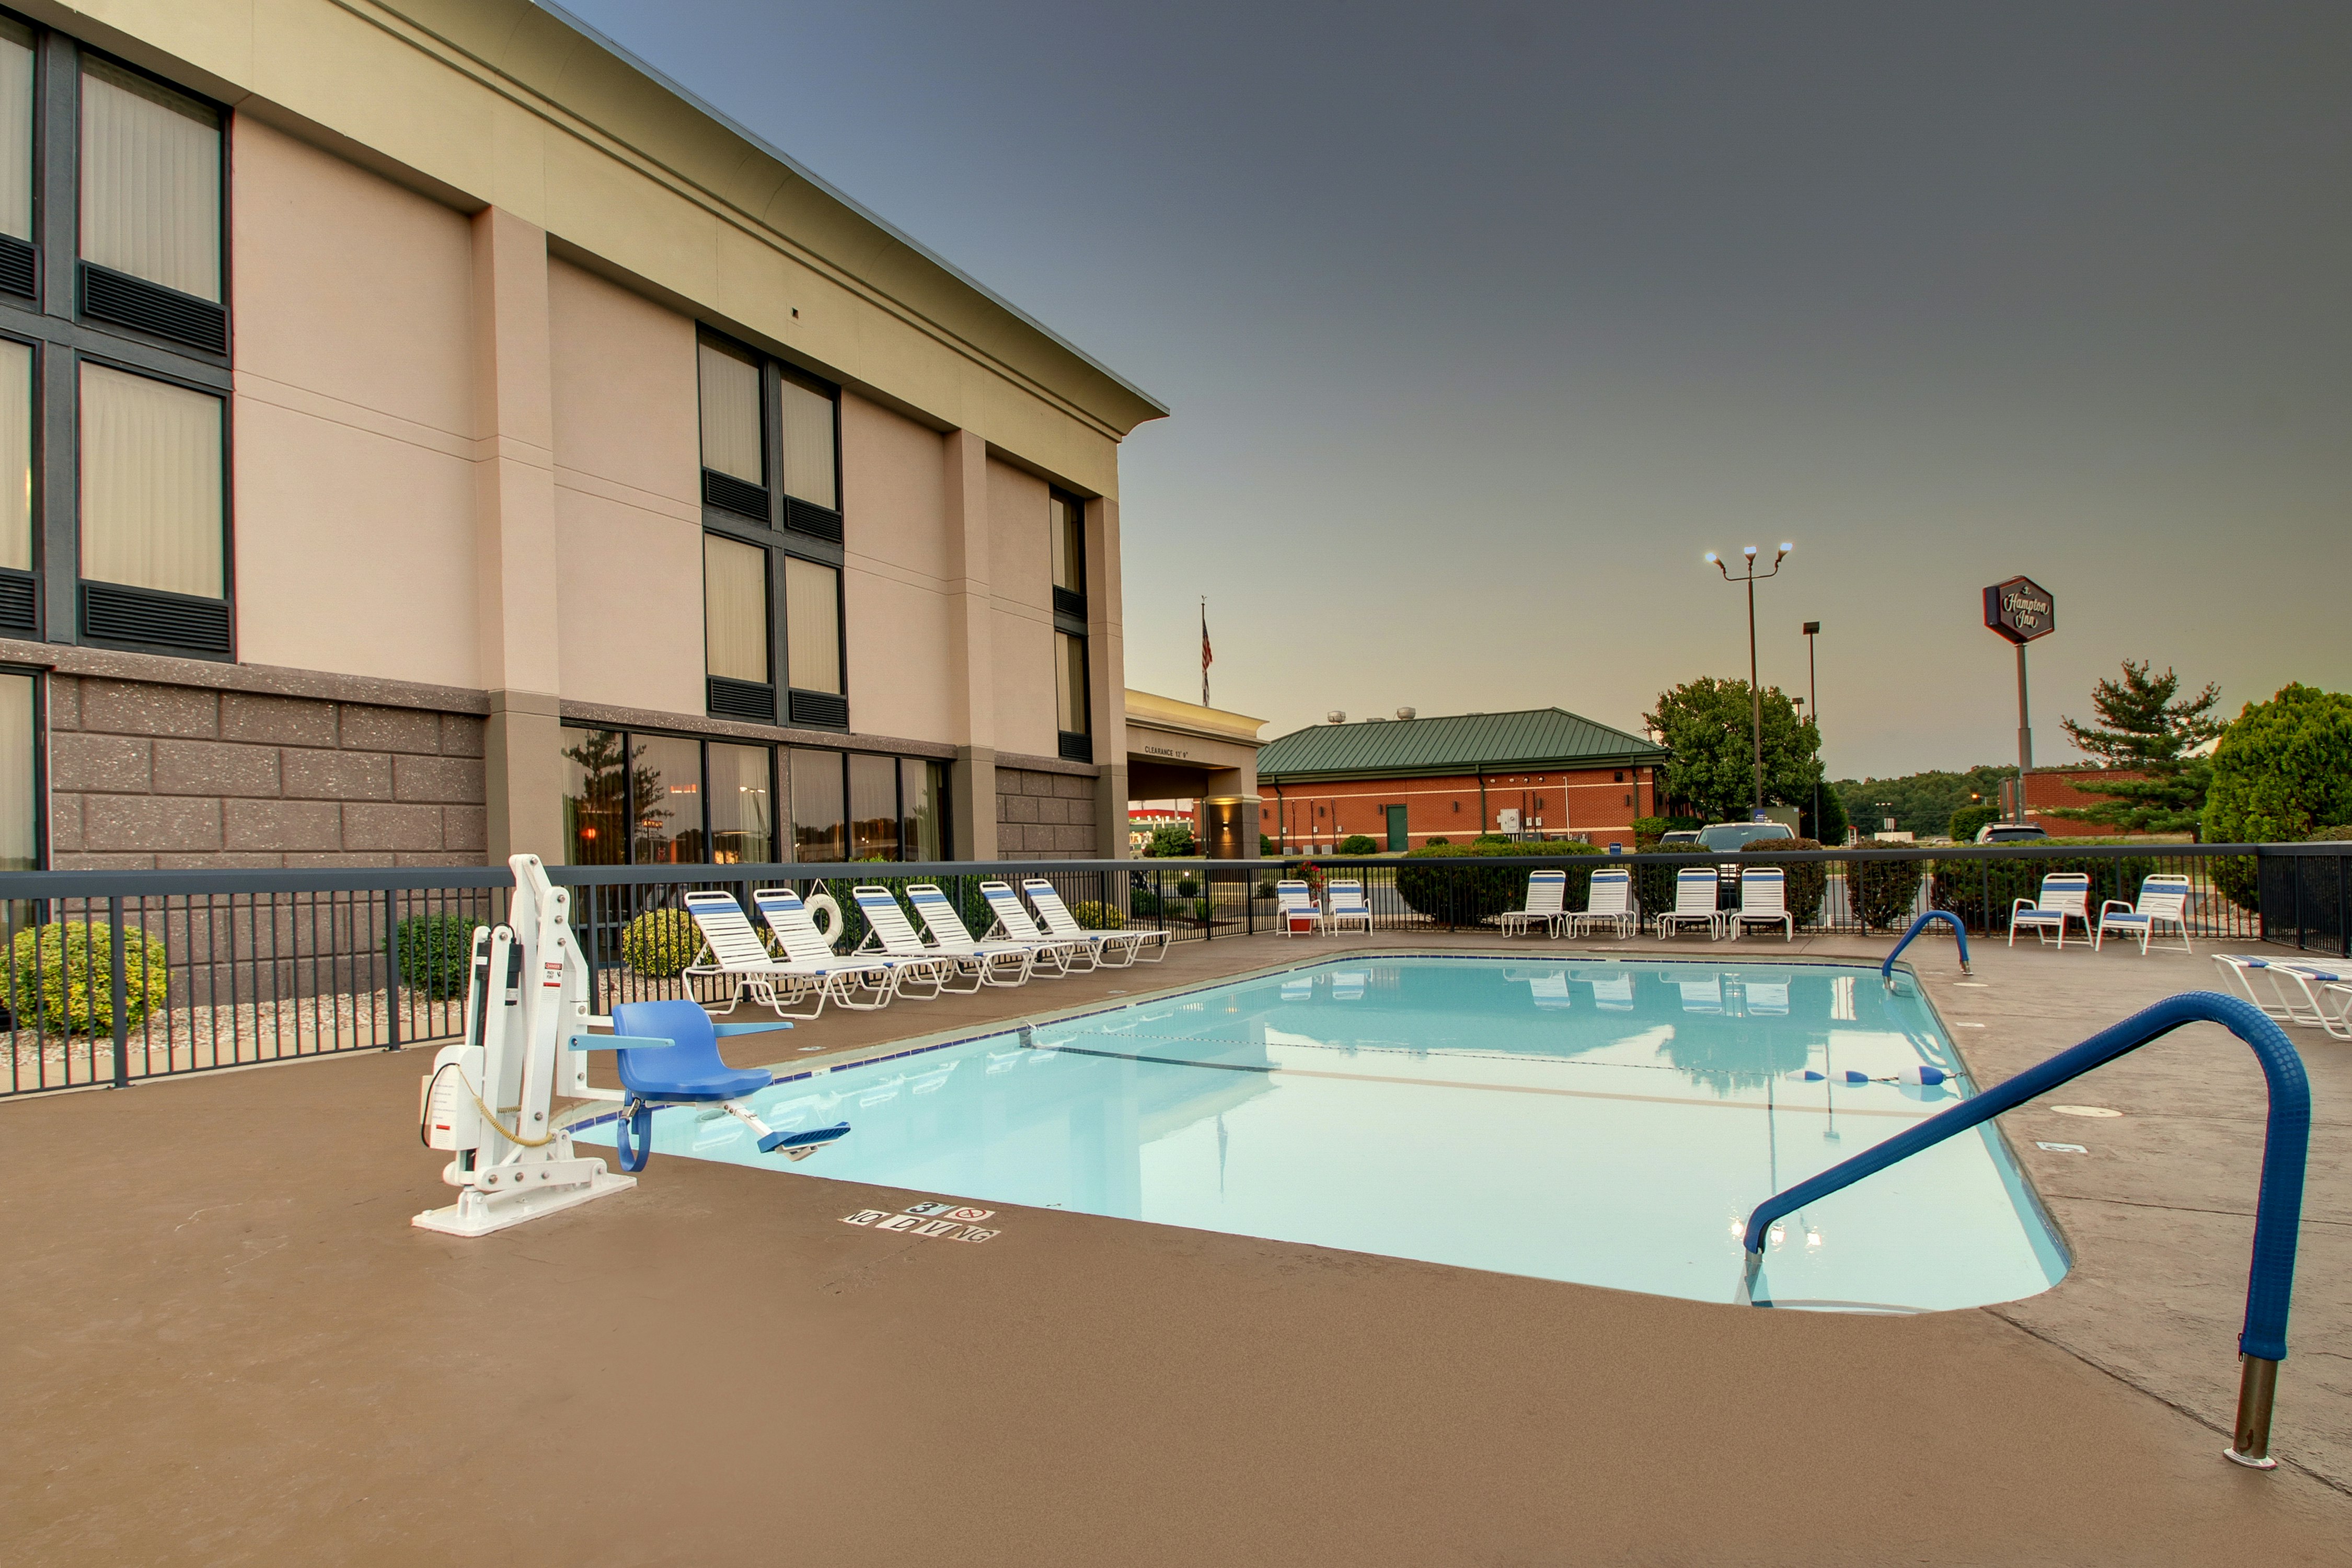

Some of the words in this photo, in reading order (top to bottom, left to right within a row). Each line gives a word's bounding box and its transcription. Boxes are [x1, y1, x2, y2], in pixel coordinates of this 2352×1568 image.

[2004, 593, 2049, 615] Hampton
[2015, 610, 2038, 628] Inn
[1145, 745, 1173, 757] CLEARANCE
[841, 1211, 883, 1223] NO
[889, 1218, 995, 1242] DVING
